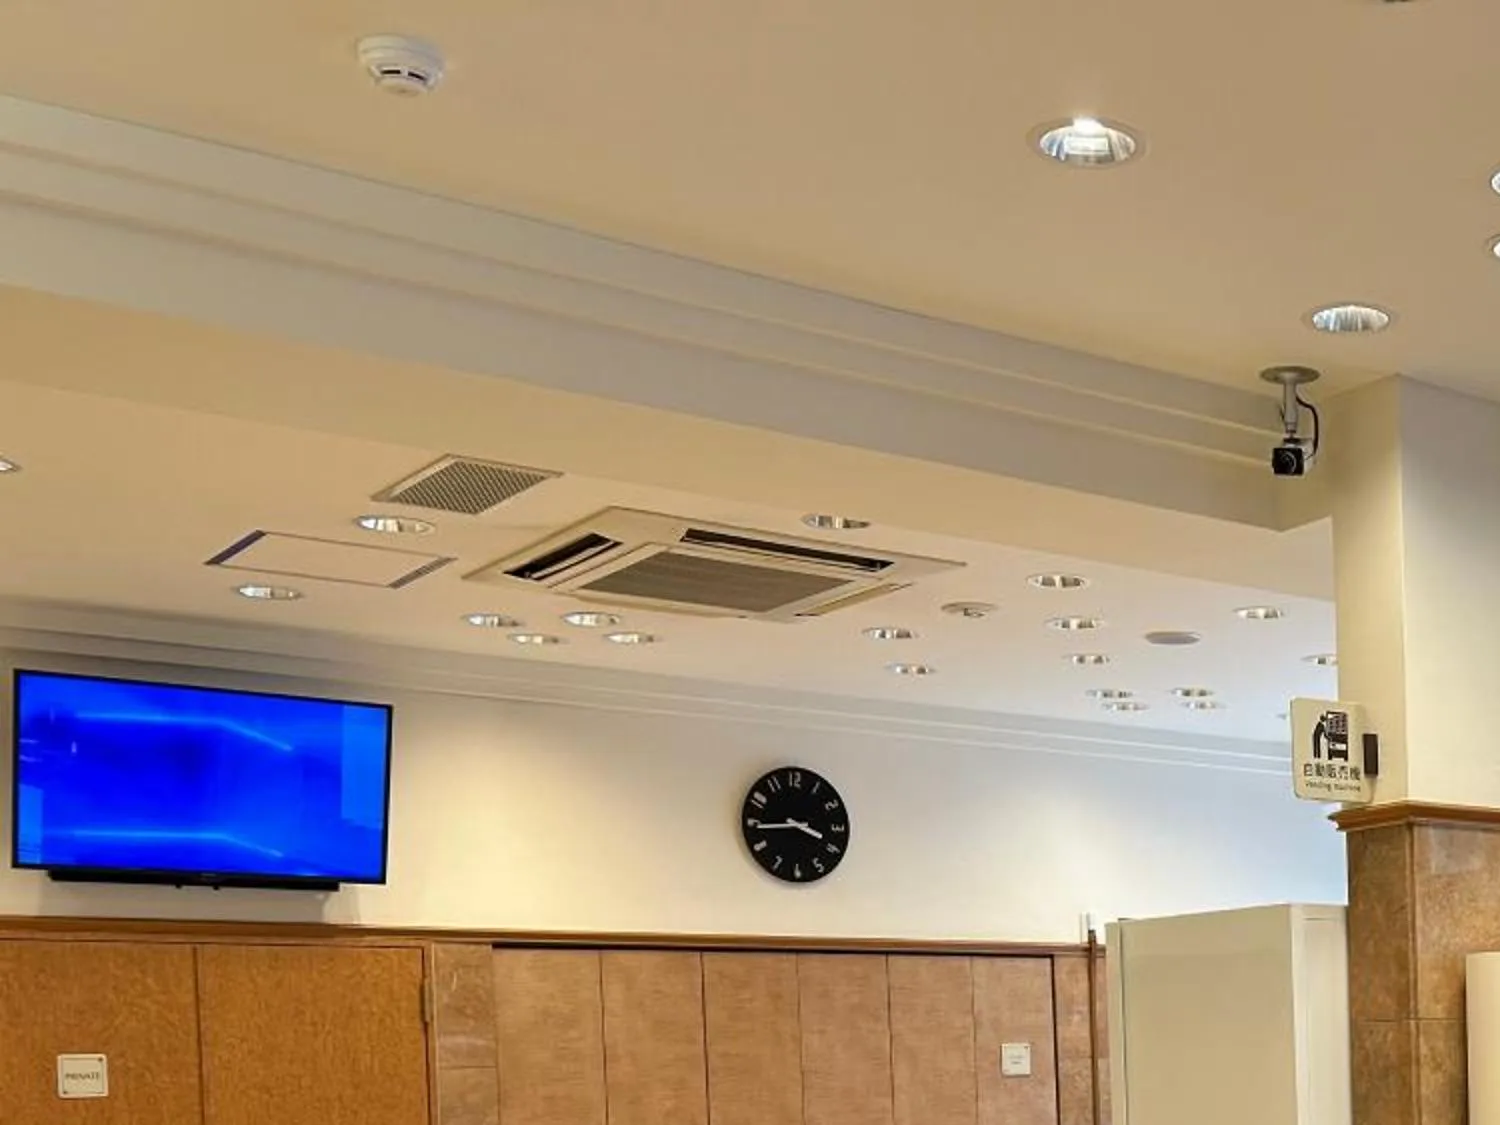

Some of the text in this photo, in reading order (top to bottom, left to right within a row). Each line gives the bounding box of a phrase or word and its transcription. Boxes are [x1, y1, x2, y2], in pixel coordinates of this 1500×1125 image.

[789, 771, 801, 788] 12
[1303, 763, 1361, 781] 自動販売機
[767, 775, 782, 793] 11
[812, 781, 821, 794] 1
[751, 791, 767, 809] 10
[825, 800, 839, 811] 2
[831, 823, 845, 833] 3
[825, 842, 841, 854] 4
[772, 855, 783, 871] 7
[793, 863, 802, 878] 6
[812, 857, 825, 873] 5
